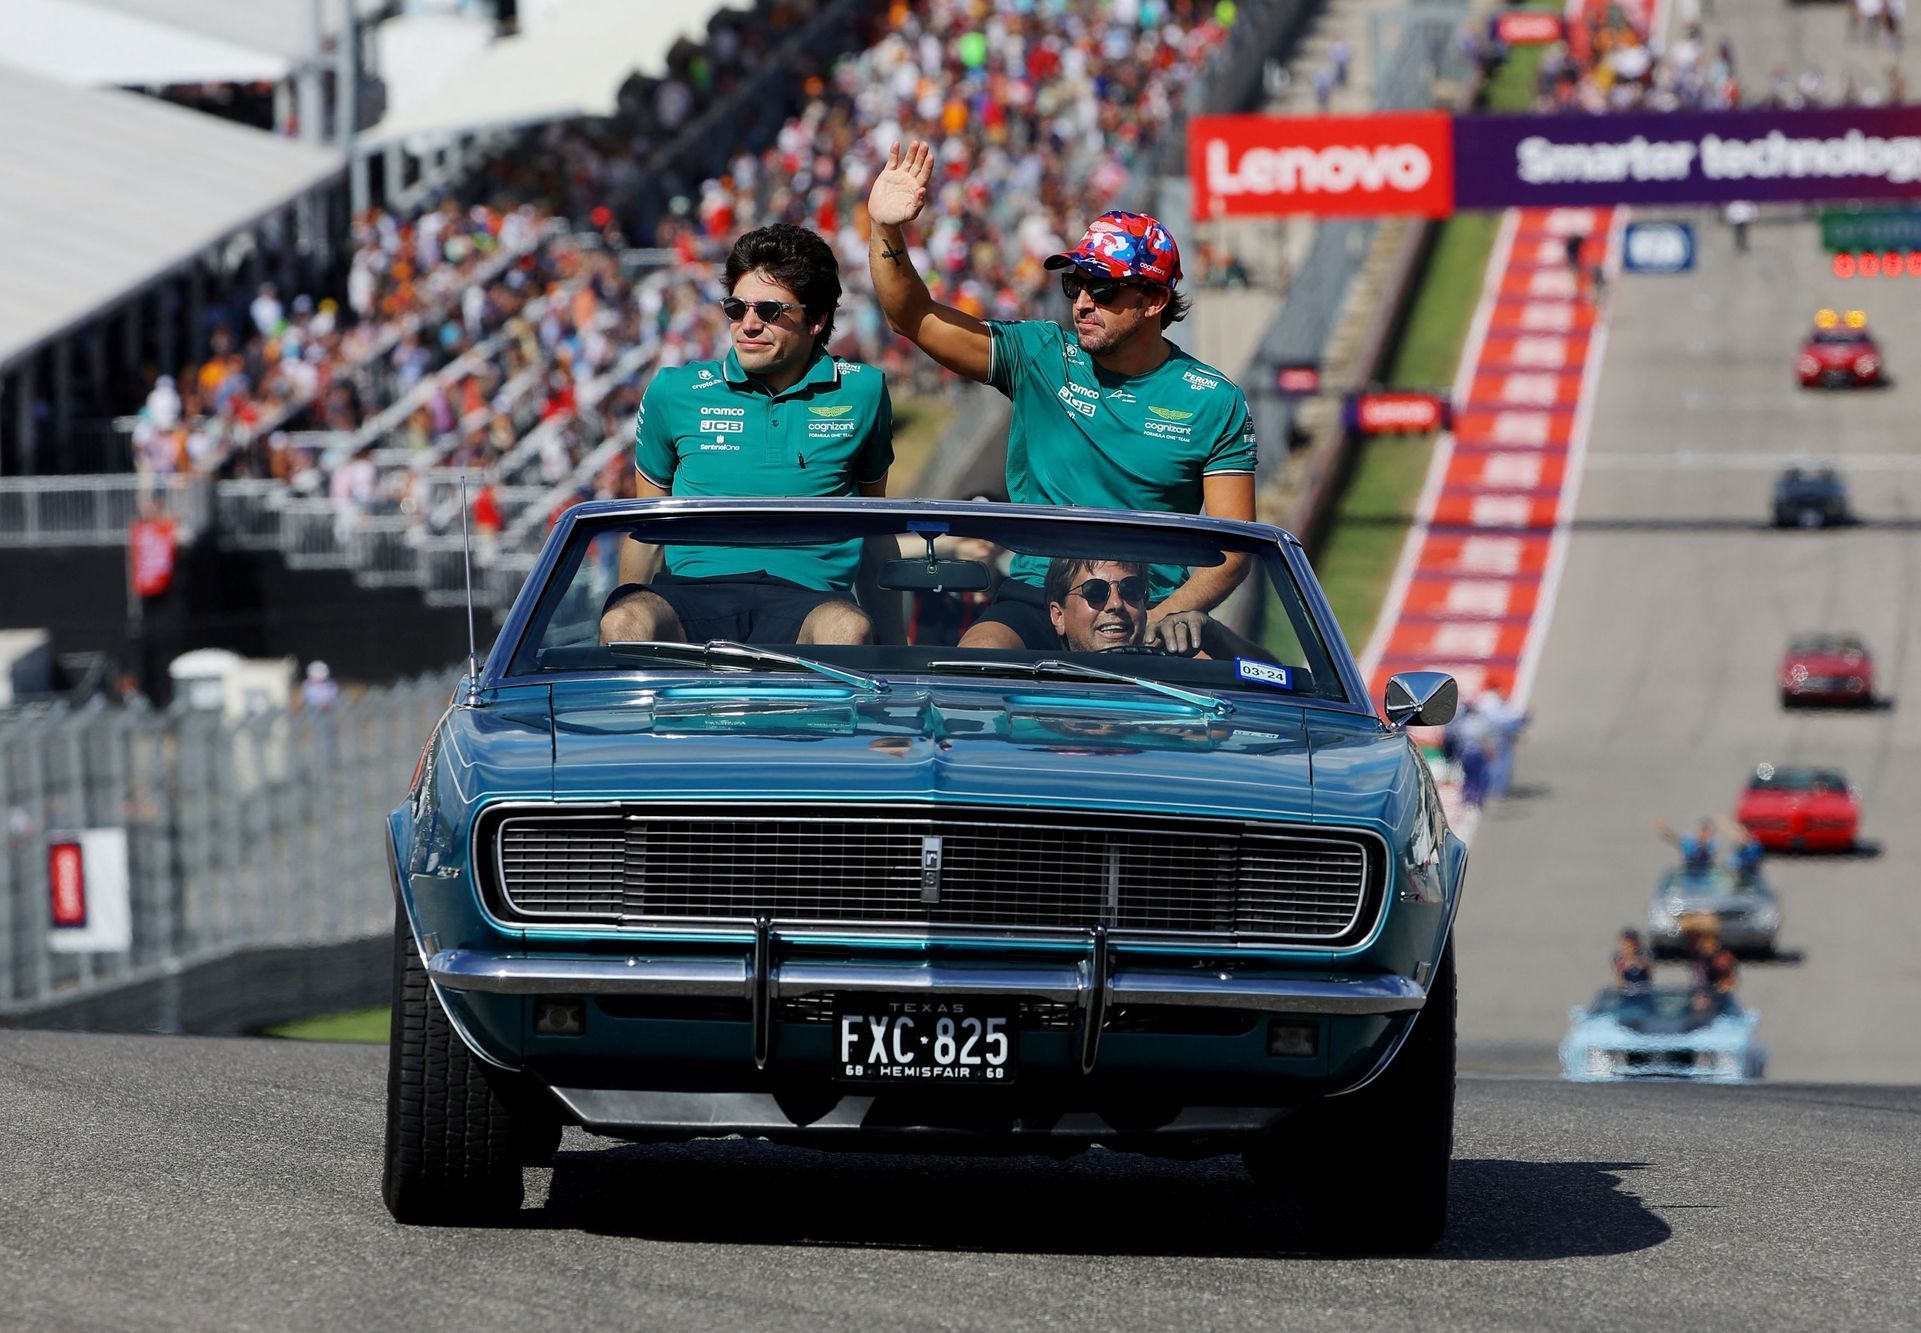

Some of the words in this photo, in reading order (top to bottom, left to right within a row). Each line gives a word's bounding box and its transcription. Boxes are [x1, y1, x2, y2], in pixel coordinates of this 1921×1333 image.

[1517, 136, 1697, 184] Smarter
[1206, 138, 1431, 195] Lenovo
[1184, 371, 1219, 387] PERONI
[700, 407, 744, 416] aramco
[701, 421, 742, 431] JCB
[808, 421, 854, 433] cognizant
[1144, 422, 1192, 435] cognizant
[1143, 430, 1166, 439] FORMULA
[700, 443, 740, 451] SentinelOne
[889, 1002, 965, 1013] TEXAS
[845, 1064, 864, 1076] 68
[880, 1065, 970, 1078] HEMISFAIR
[986, 1067, 1004, 1079] 68
